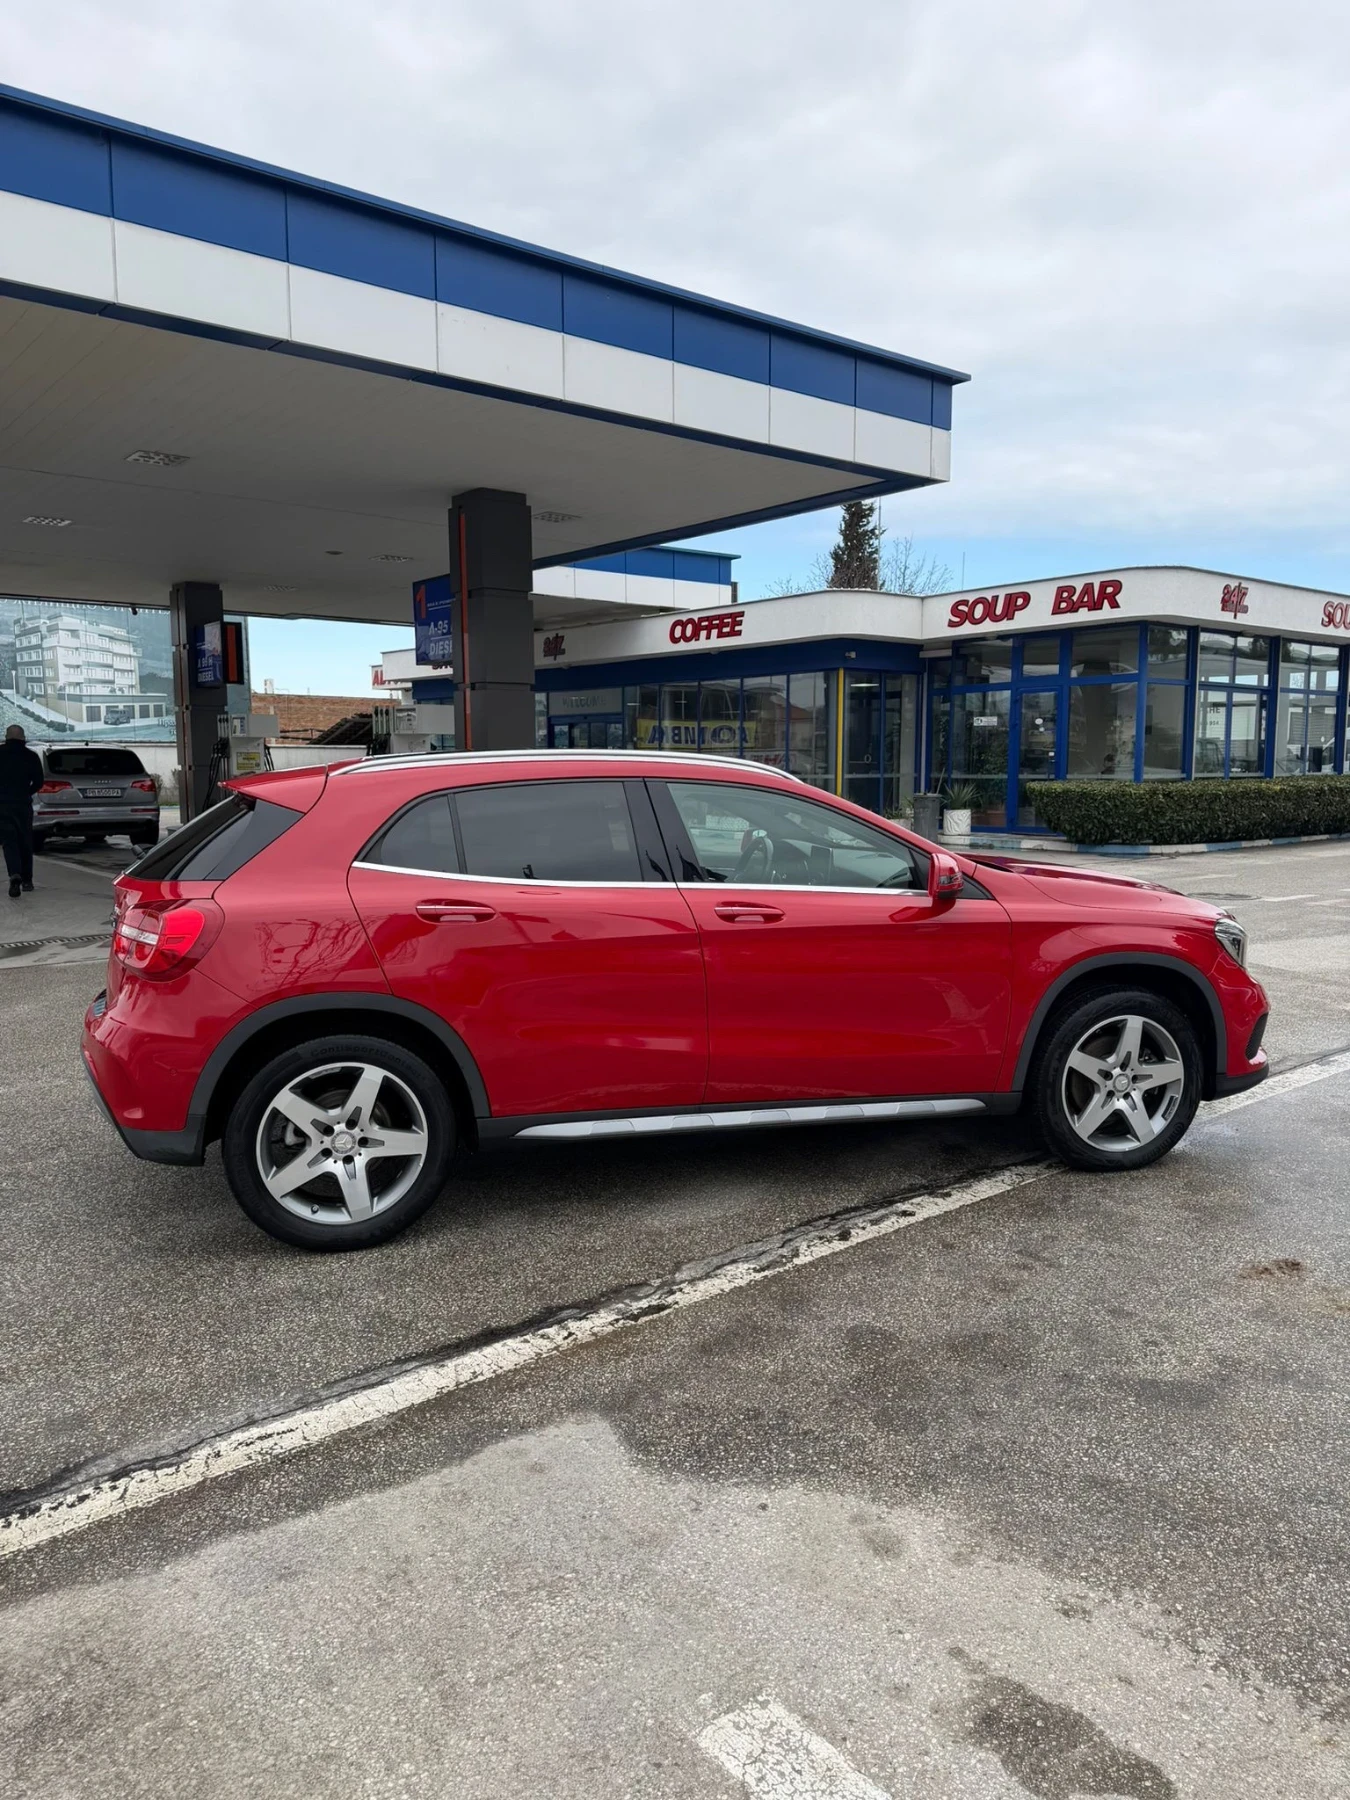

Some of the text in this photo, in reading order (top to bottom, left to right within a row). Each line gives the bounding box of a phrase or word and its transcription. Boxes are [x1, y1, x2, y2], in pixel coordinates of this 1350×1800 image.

[416, 585, 427, 619] 1
[947, 579, 1123, 628] SOUP BAR
[669, 610, 745, 644] COFFEE
[429, 639, 452, 655] DIES
